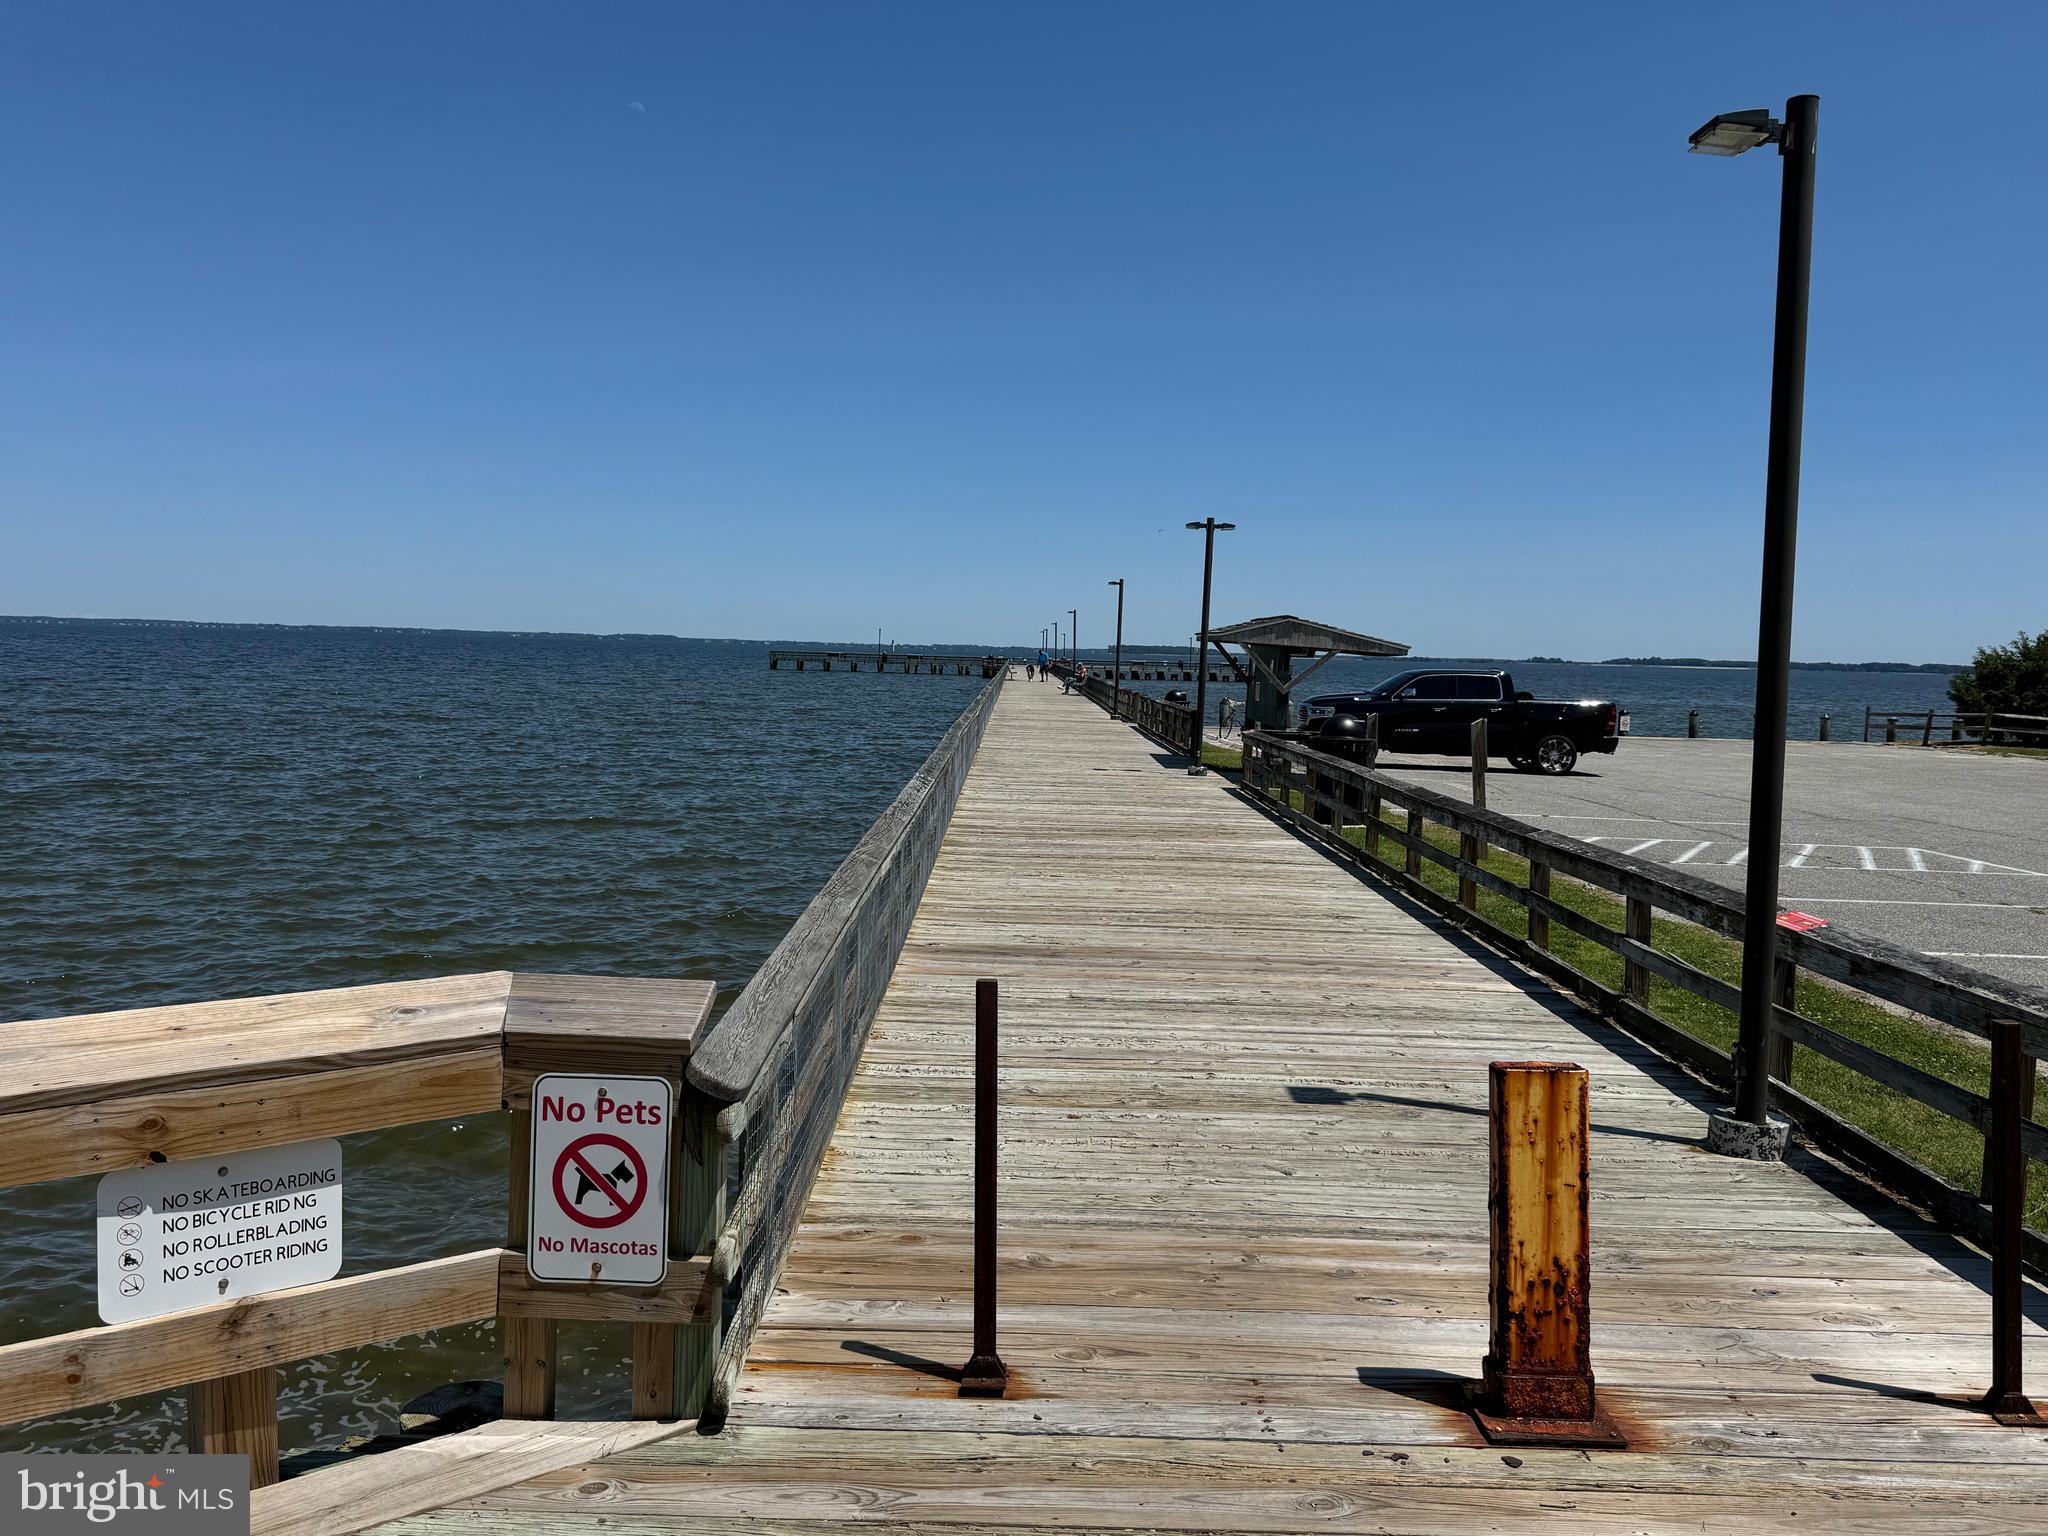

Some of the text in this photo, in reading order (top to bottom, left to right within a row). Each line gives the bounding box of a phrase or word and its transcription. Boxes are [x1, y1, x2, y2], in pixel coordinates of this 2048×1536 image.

[542, 1096, 661, 1125] No Pets
[162, 1168, 335, 1210] NO SKATEBOARDING
[162, 1194, 317, 1234] NO BICYCLE RIDNG
[162, 1215, 327, 1258] NO ROLLERBLADING
[538, 1236, 658, 1256] No Mascotas
[163, 1238, 328, 1283] NO SCOOTER RIDING
